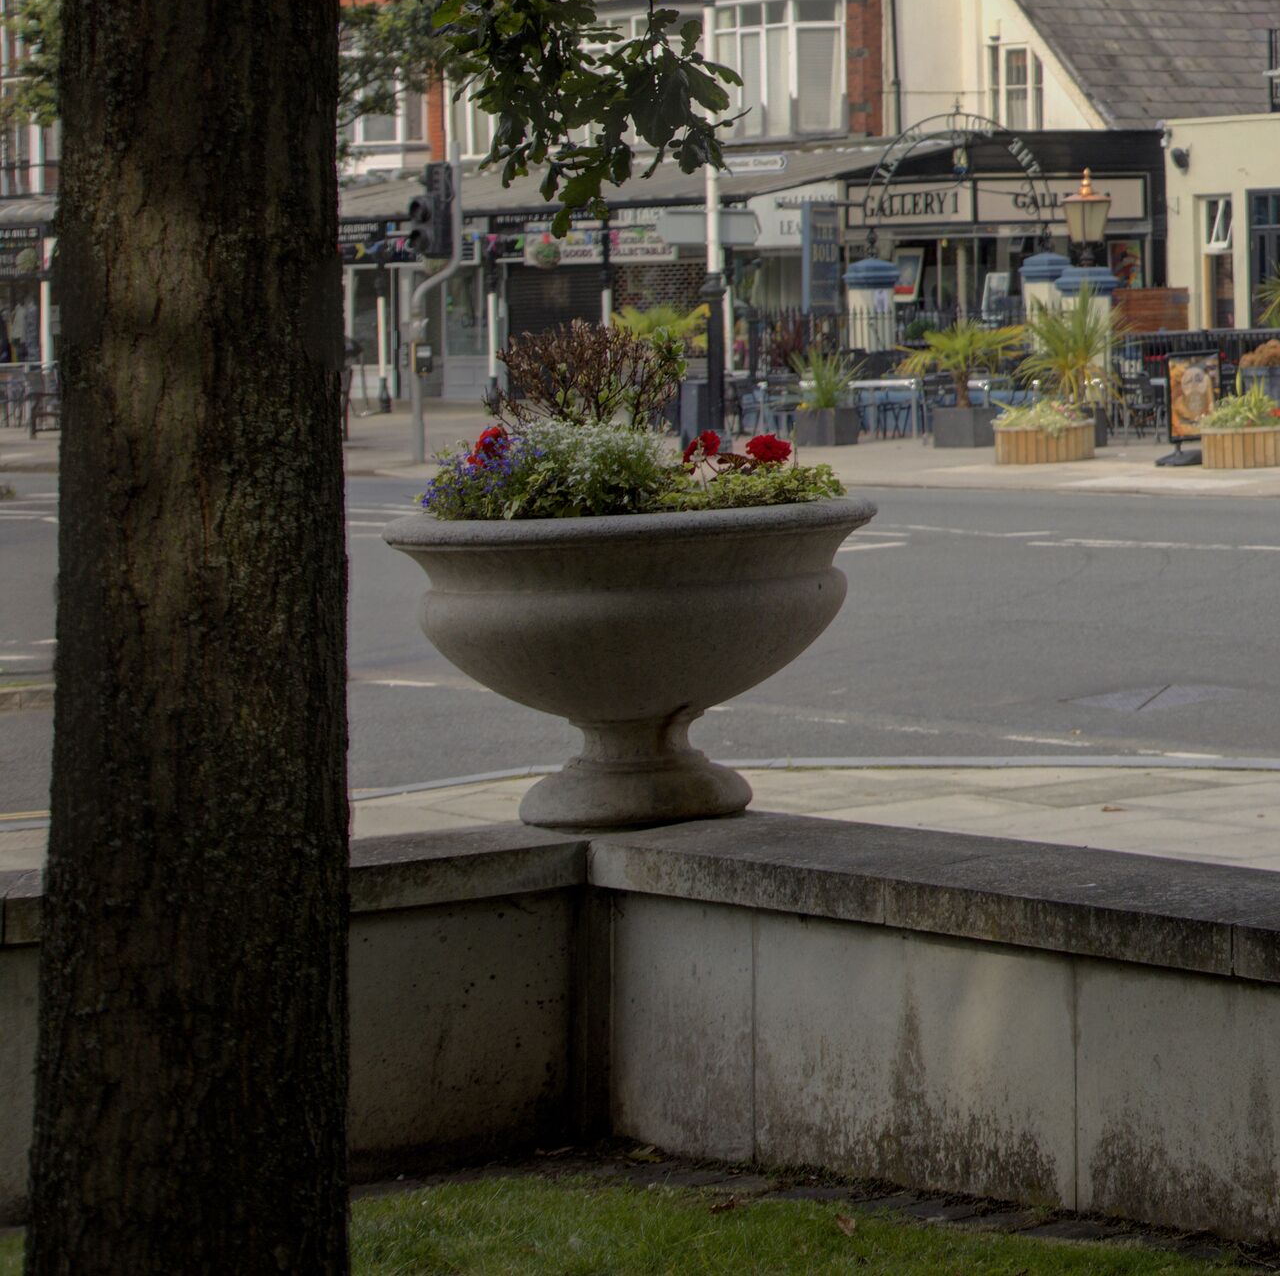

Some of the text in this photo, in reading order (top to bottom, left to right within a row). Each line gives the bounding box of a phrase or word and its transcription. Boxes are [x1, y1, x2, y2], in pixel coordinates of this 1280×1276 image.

[863, 191, 960, 220] GALLERY 1
[814, 224, 835, 240] THE
[812, 244, 837, 262] BOLD
